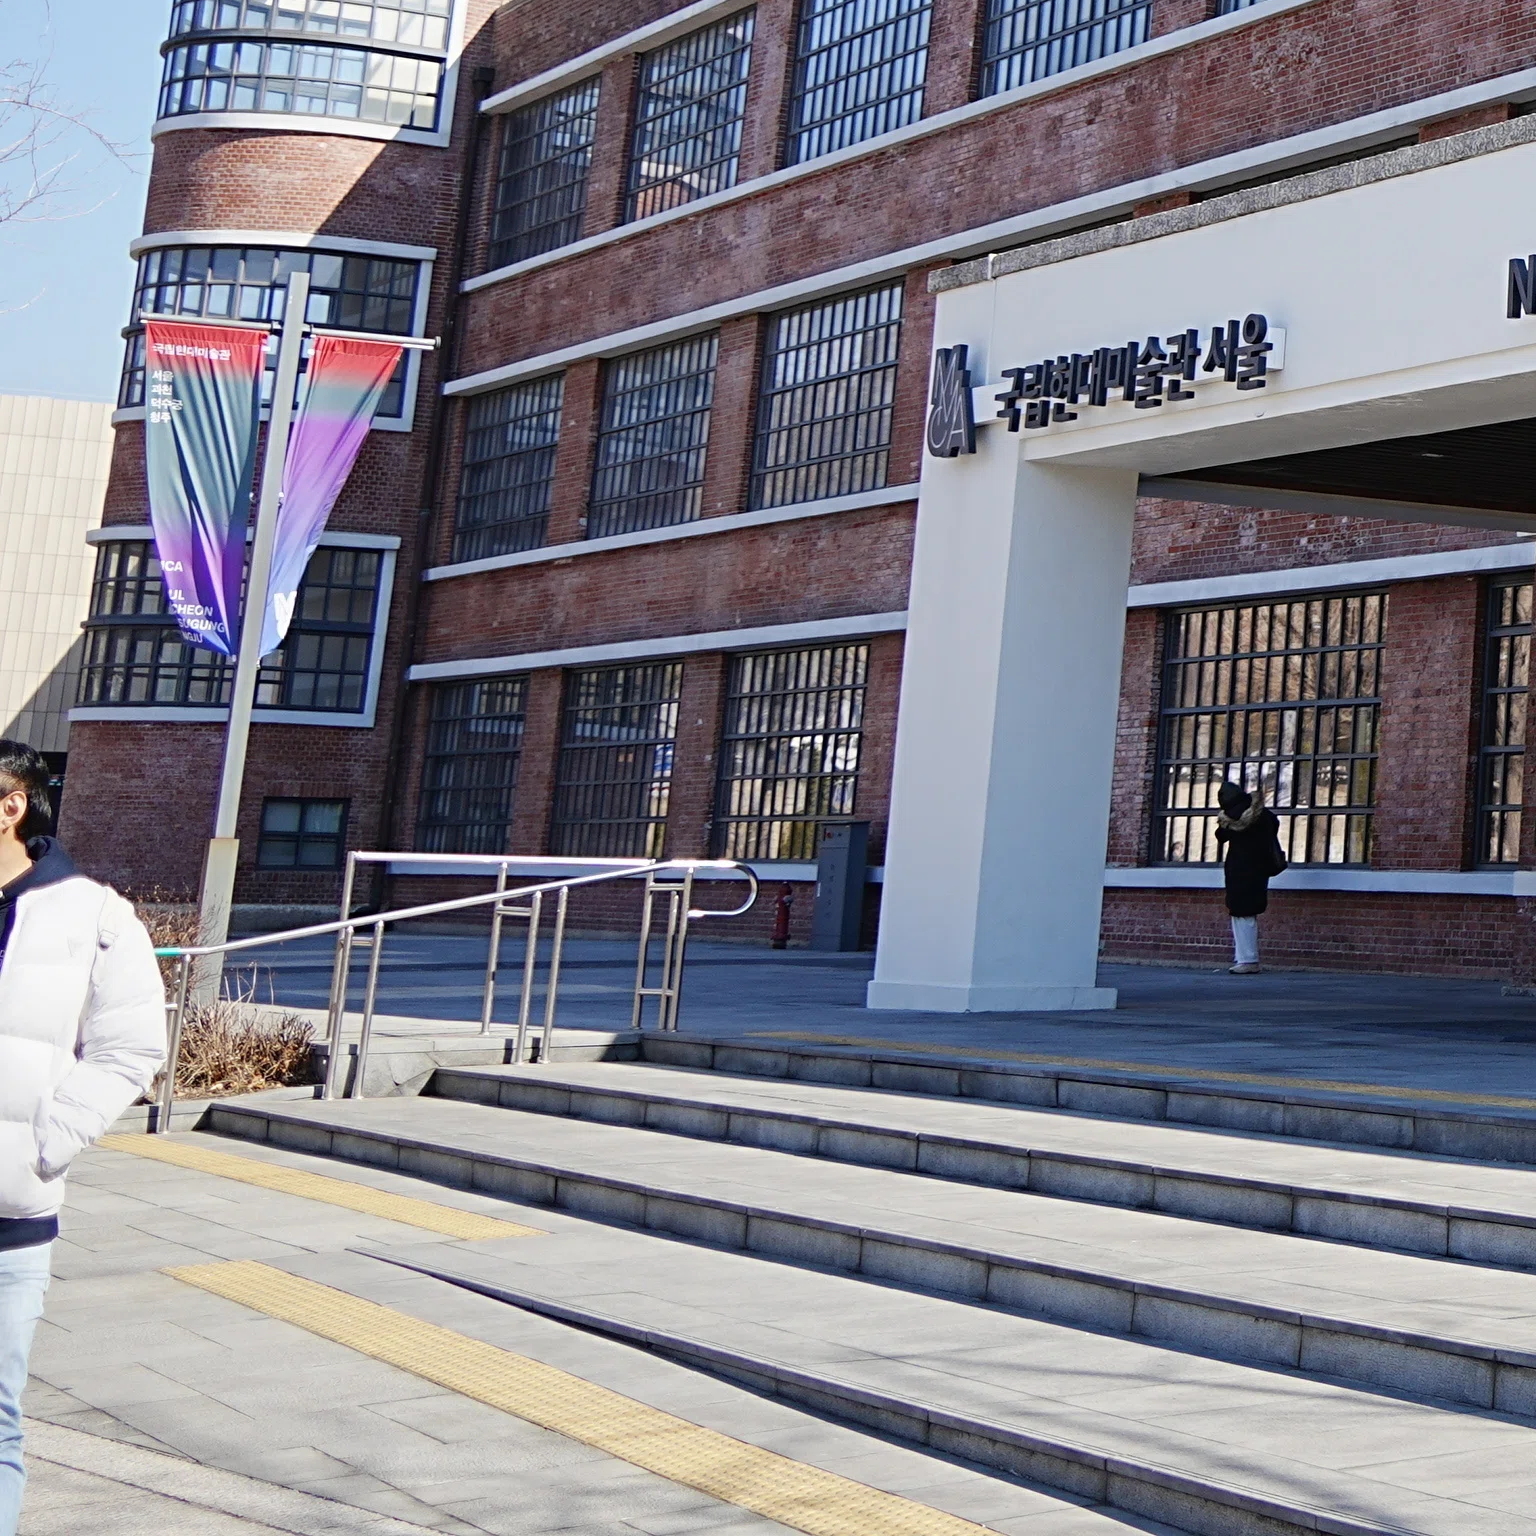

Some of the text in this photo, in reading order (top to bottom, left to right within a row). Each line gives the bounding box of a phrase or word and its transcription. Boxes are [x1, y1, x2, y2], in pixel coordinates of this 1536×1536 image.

[152, 370, 174, 382] 서울
[995, 314, 1273, 432] 국립현대미술관 서울
[151, 384, 173, 395] 과천
[151, 398, 183, 411] 덕수궁
[150, 411, 171, 423] 청주
